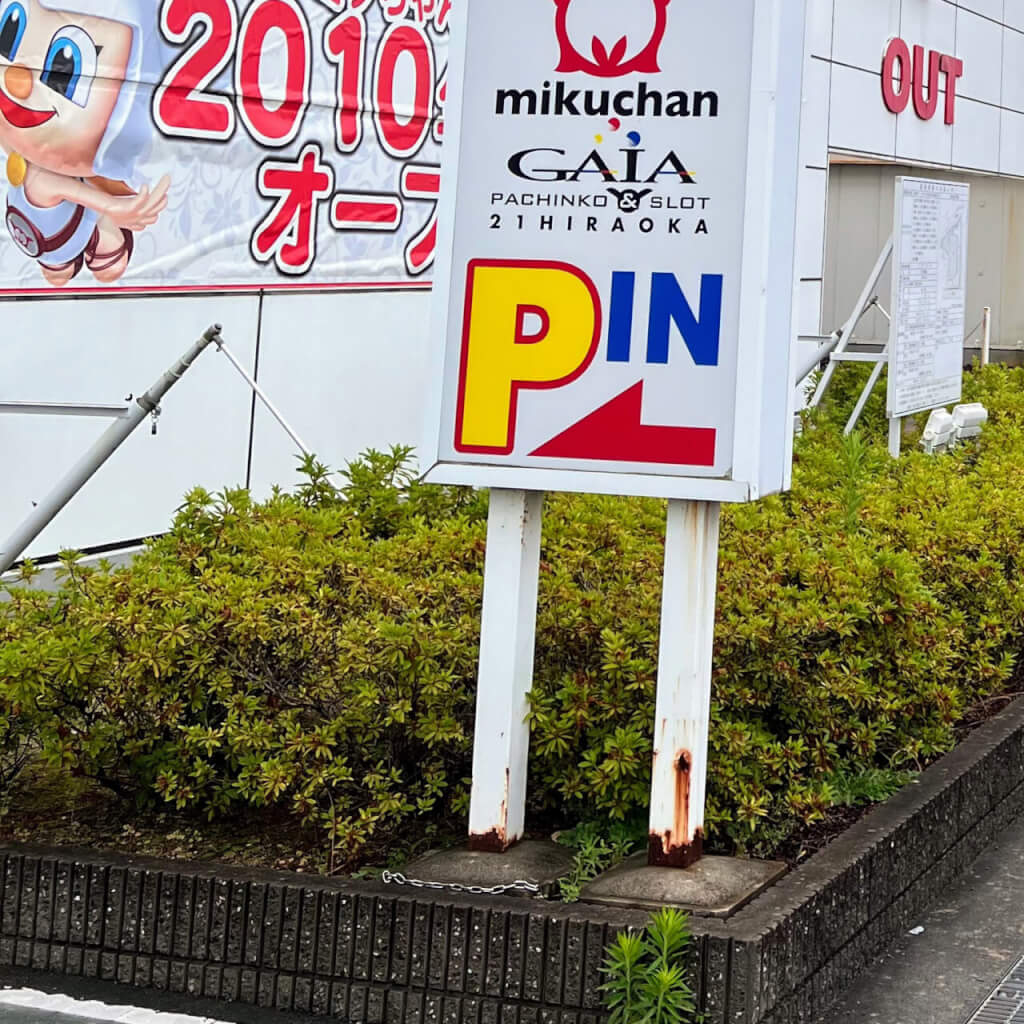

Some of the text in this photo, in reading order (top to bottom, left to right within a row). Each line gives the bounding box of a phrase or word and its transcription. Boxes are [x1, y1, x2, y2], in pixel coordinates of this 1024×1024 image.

[495, 81, 719, 117] mikuchan
[881, 37, 963, 125] OUT
[507, 139, 697, 184] GAIA
[491, 191, 711, 210] PACHINKO & SLOT
[454, 258, 723, 455] P IN
